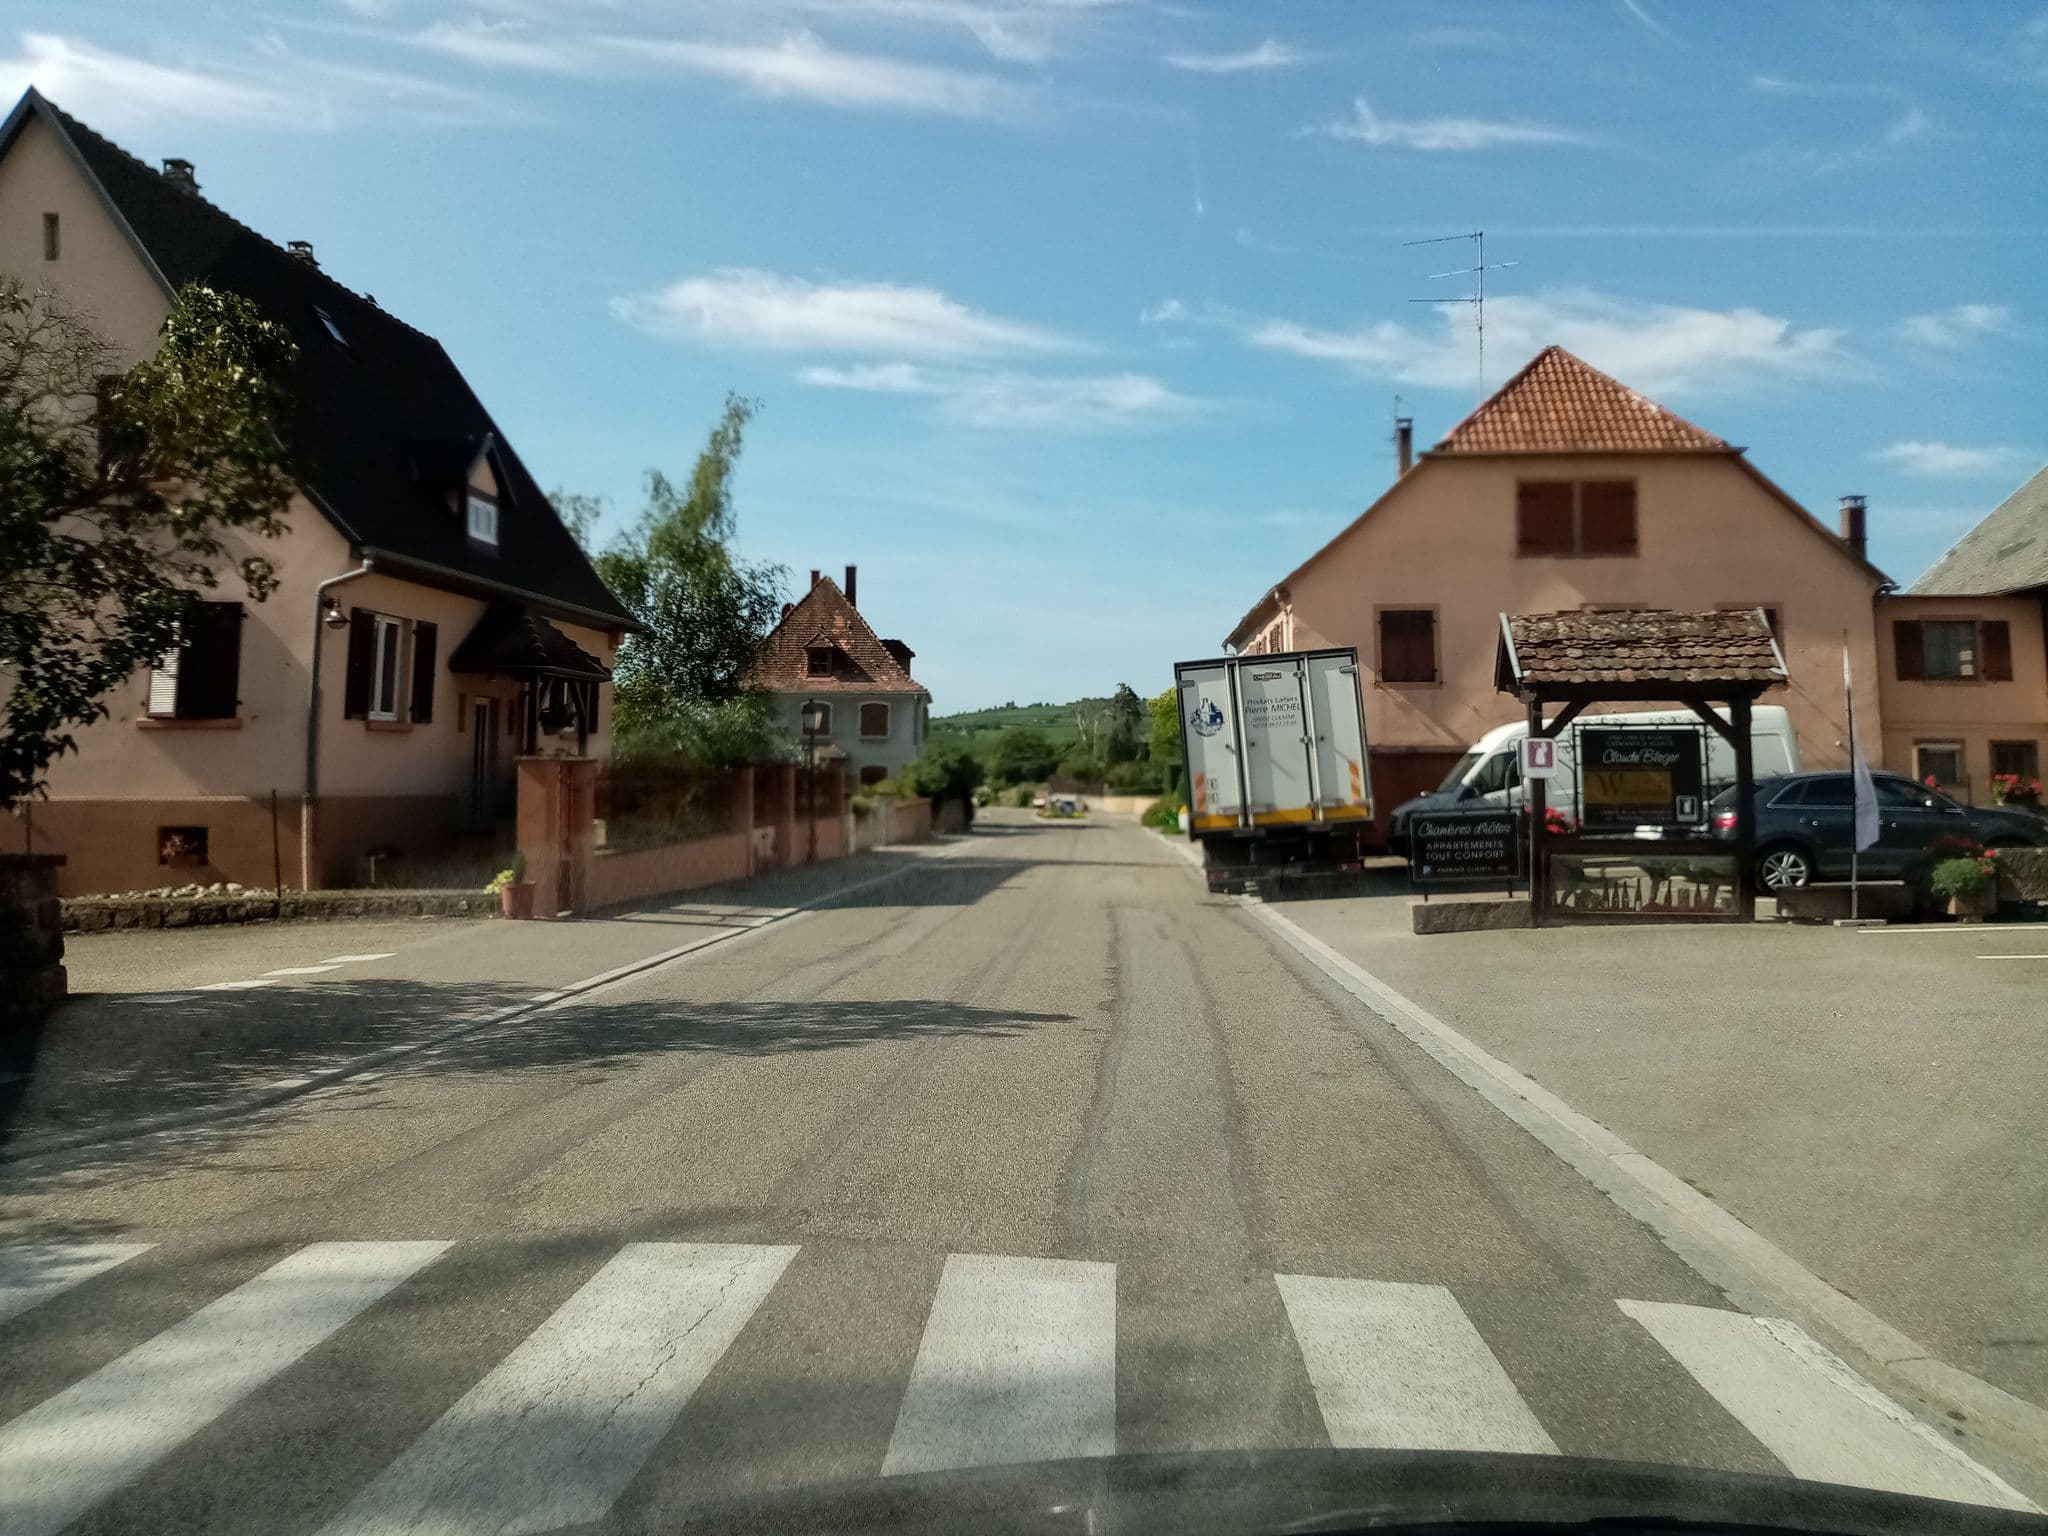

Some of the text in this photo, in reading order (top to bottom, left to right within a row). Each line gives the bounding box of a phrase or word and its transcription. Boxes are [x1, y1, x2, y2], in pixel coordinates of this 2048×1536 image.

[1271, 703, 1302, 712] MICHEL
[1418, 821, 1471, 837] Chambres
[1426, 840, 1504, 850] APPARTEMENTS
[1426, 850, 1504, 861] TOUT CONFORT
